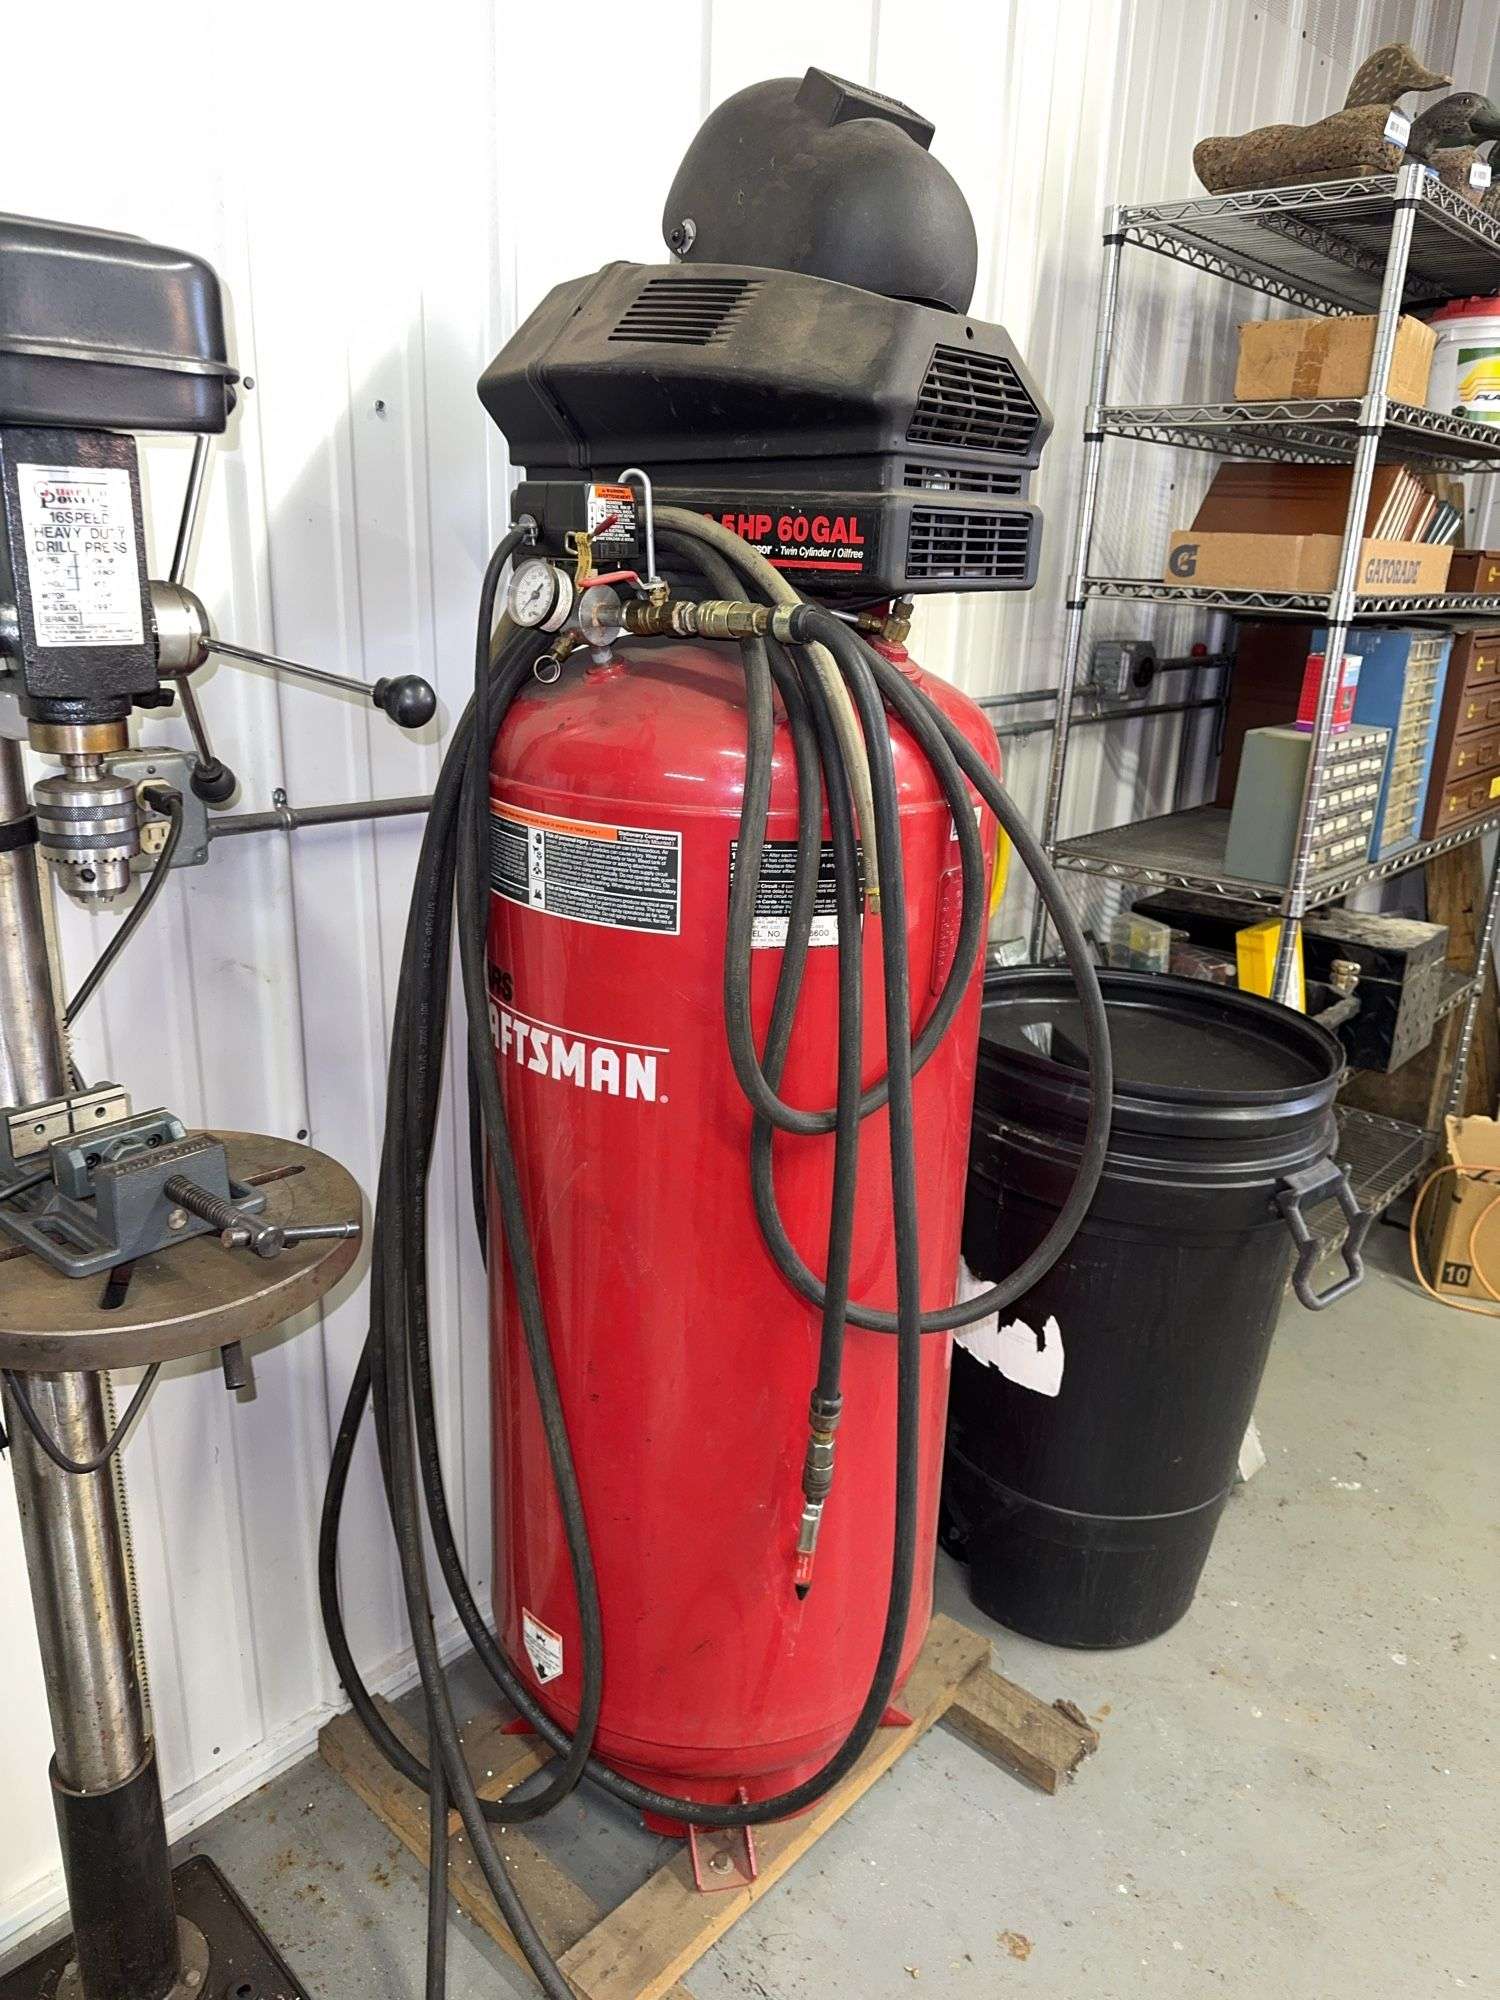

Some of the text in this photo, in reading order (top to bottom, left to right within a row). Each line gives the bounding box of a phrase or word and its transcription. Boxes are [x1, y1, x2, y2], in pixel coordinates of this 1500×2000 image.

[34, 527, 80, 538] HEAVY
[36, 540, 128, 553] DRILL PRESS
[780, 546, 798, 555] Twin
[799, 547, 832, 558] Cylinder
[837, 549, 864, 558] Oilfree
[1169, 544, 1200, 577] G
[1366, 558, 1421, 584] GATORADE
[618, 829, 676, 842] Stationary Compressor
[488, 1001, 656, 1102] AFTSMAN
[1446, 1266, 1468, 1284] 10
